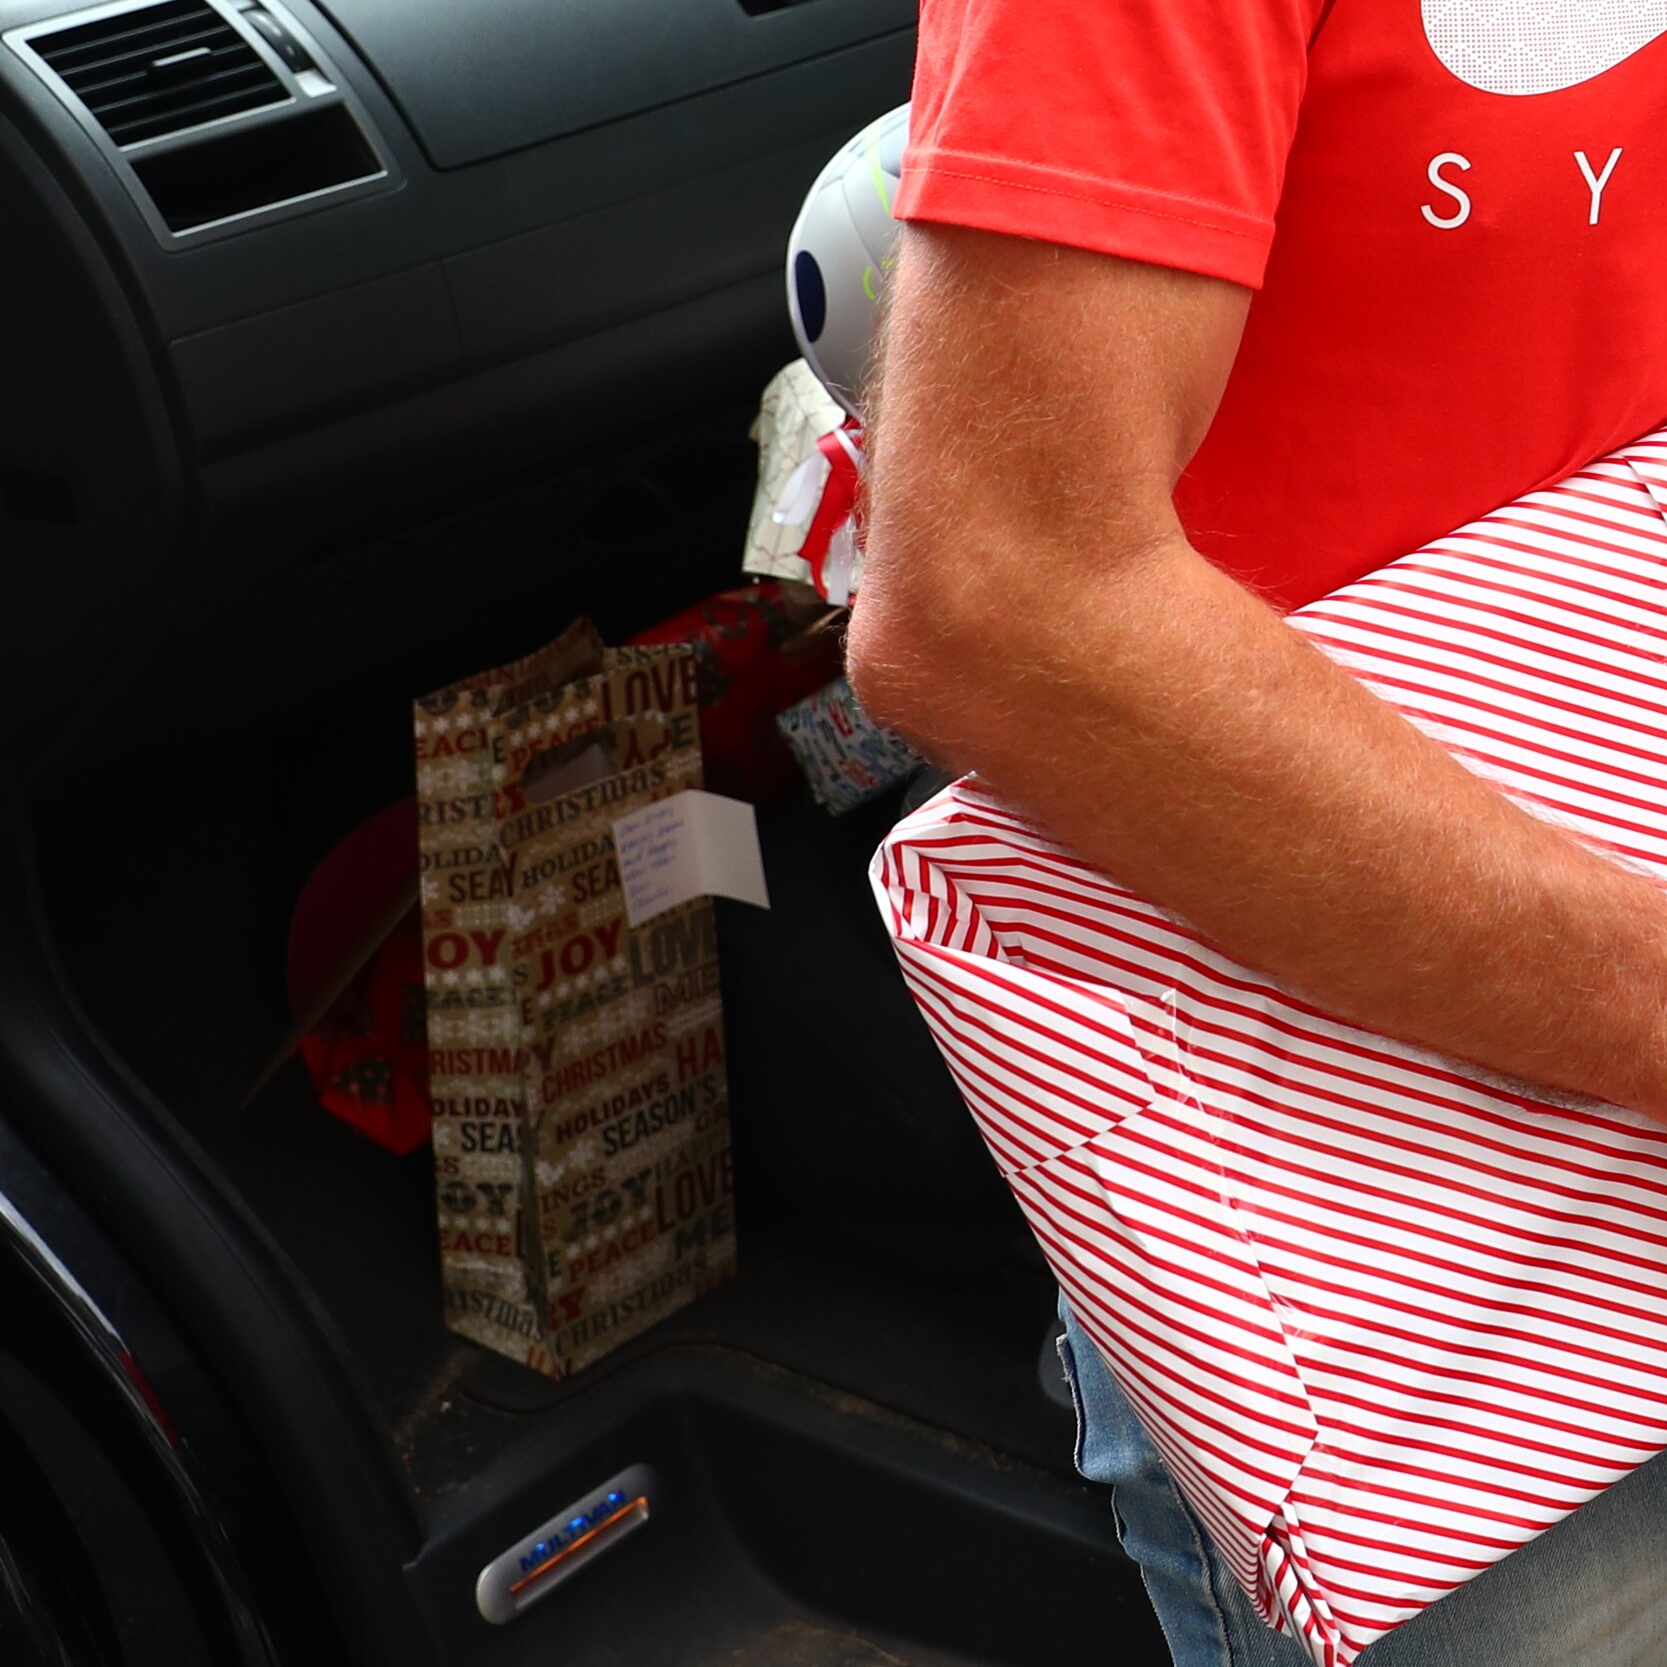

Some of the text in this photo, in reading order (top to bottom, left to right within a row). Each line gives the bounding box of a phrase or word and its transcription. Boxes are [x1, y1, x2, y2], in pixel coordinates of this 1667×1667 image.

[536, 918, 622, 992] JOY
[541, 1022, 668, 1106] CHRISTMAS
[556, 1073, 670, 1145] HOLIDAYS
